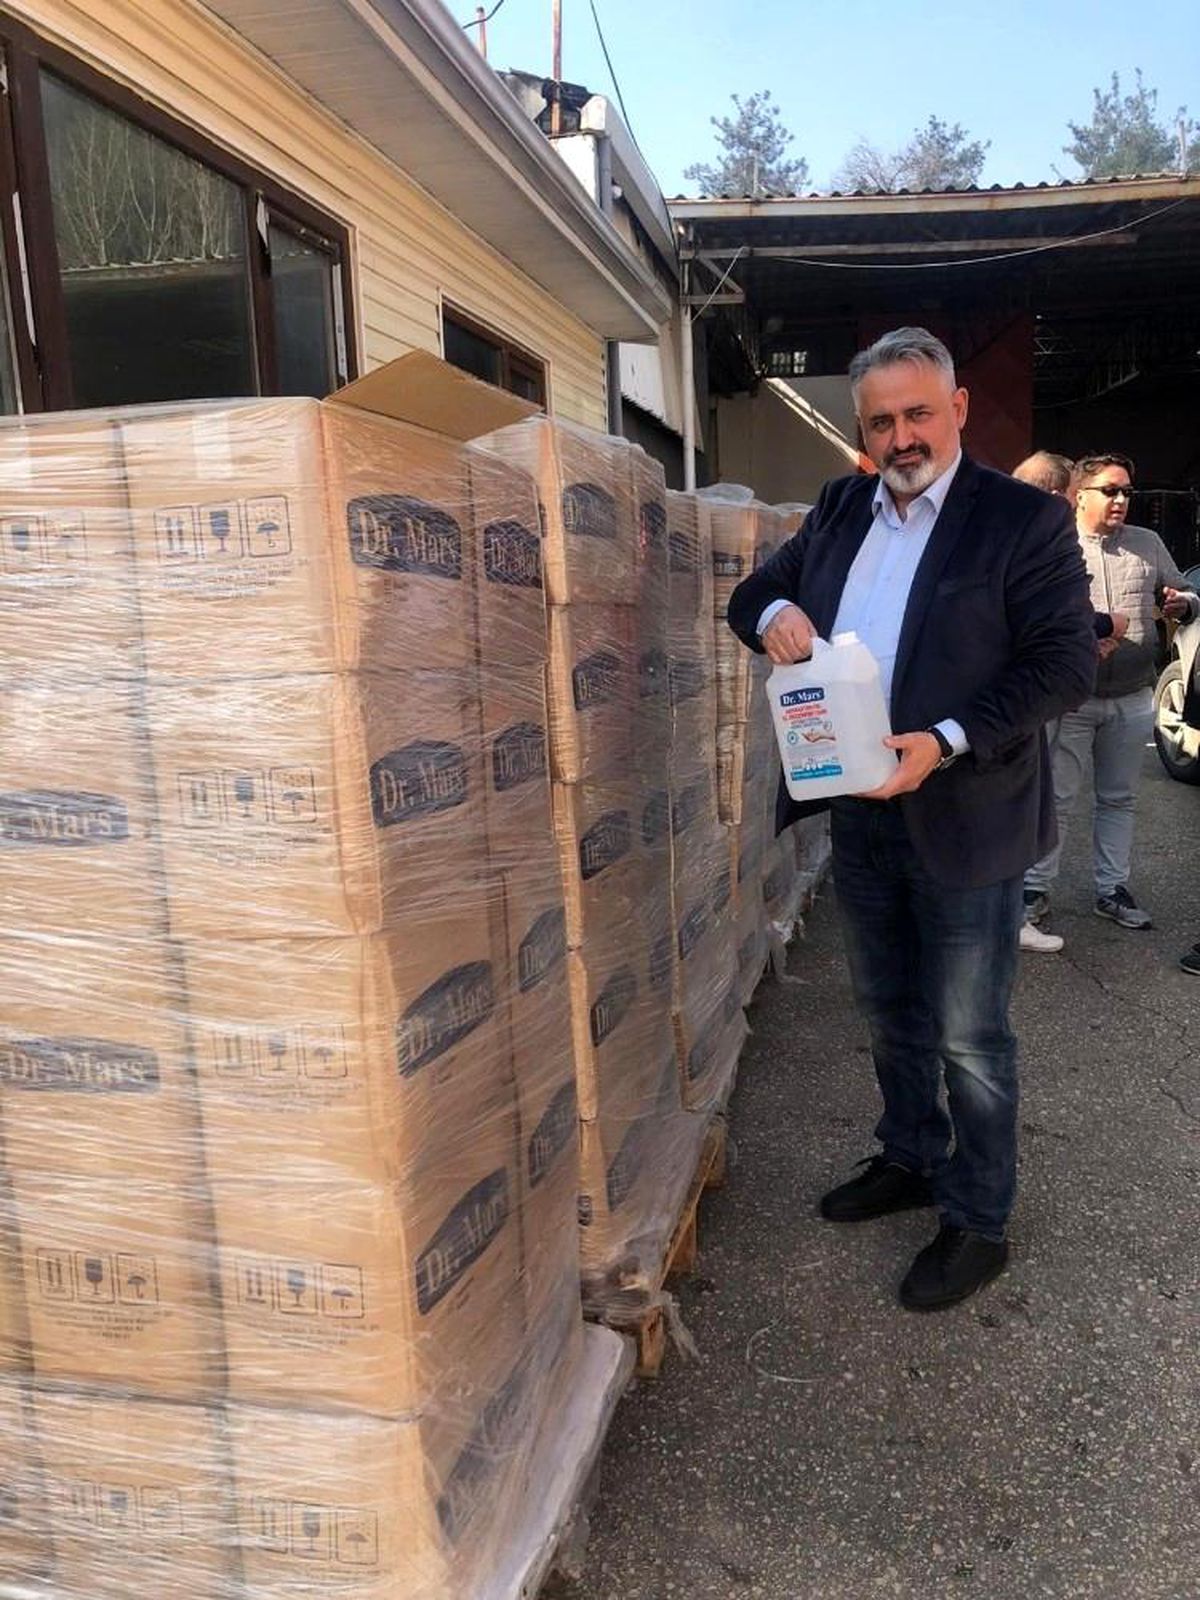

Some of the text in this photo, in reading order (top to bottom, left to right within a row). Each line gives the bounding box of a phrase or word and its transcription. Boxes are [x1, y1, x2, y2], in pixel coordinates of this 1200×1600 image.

[358, 508, 400, 558] Dr.
[783, 690, 823, 705] Dr. Mars
[379, 768, 415, 812] Dr.
[425, 1248, 461, 1295] Dr.
